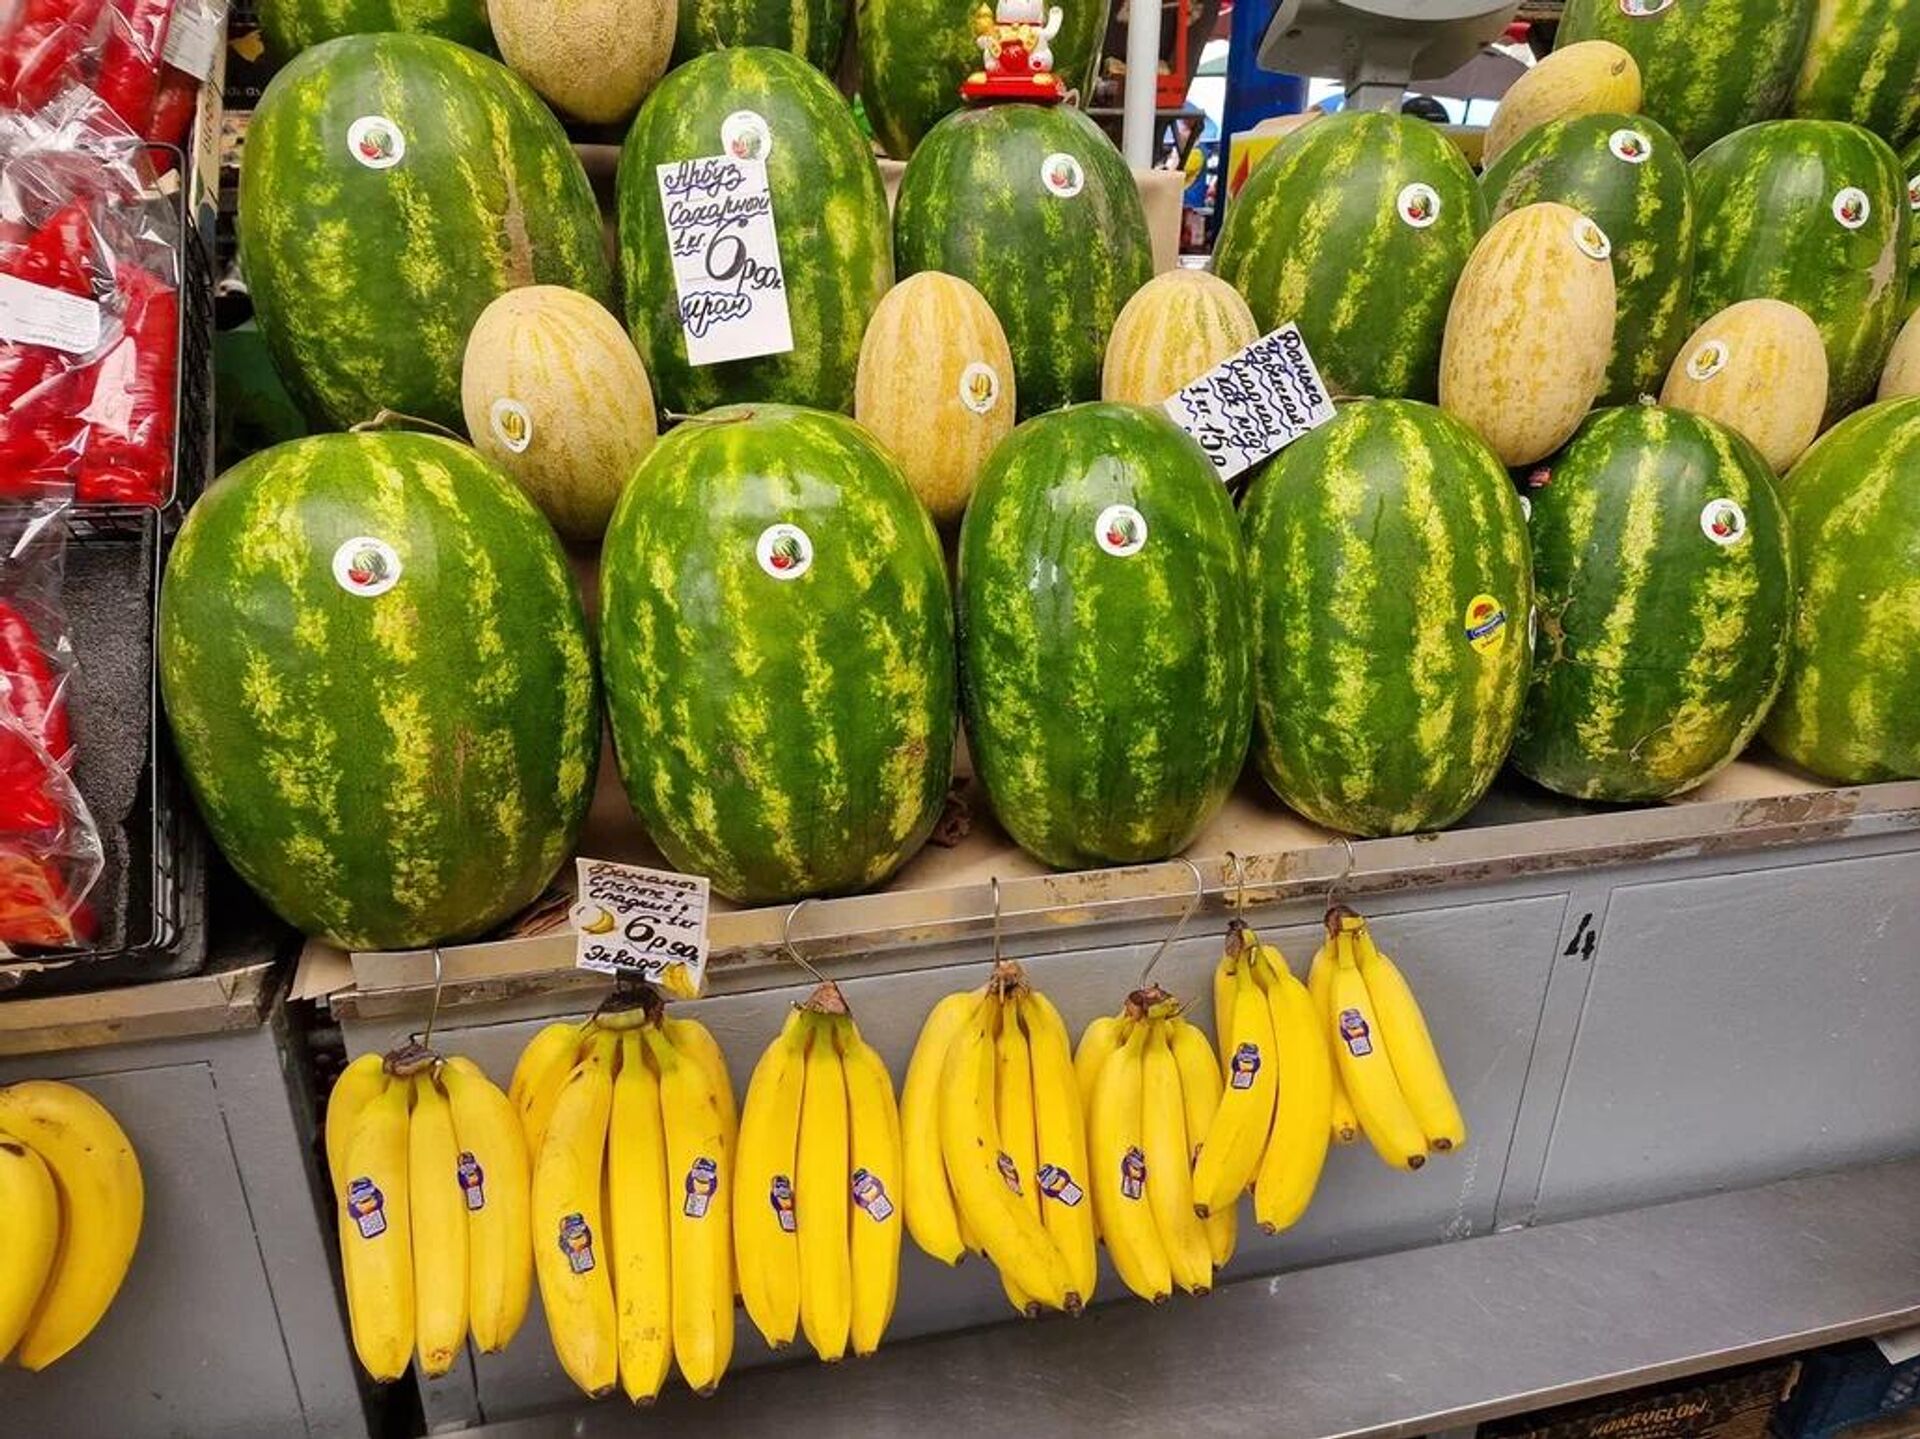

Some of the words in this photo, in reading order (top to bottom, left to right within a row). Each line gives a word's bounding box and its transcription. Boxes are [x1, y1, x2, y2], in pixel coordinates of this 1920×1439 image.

[664, 160, 746, 200] Арбуз
[669, 189, 769, 228] Сахарный
[588, 863, 697, 890] Бананы
[1563, 912, 1595, 961] 4
[1589, 1399, 1708, 1438] HONEYGLOW
